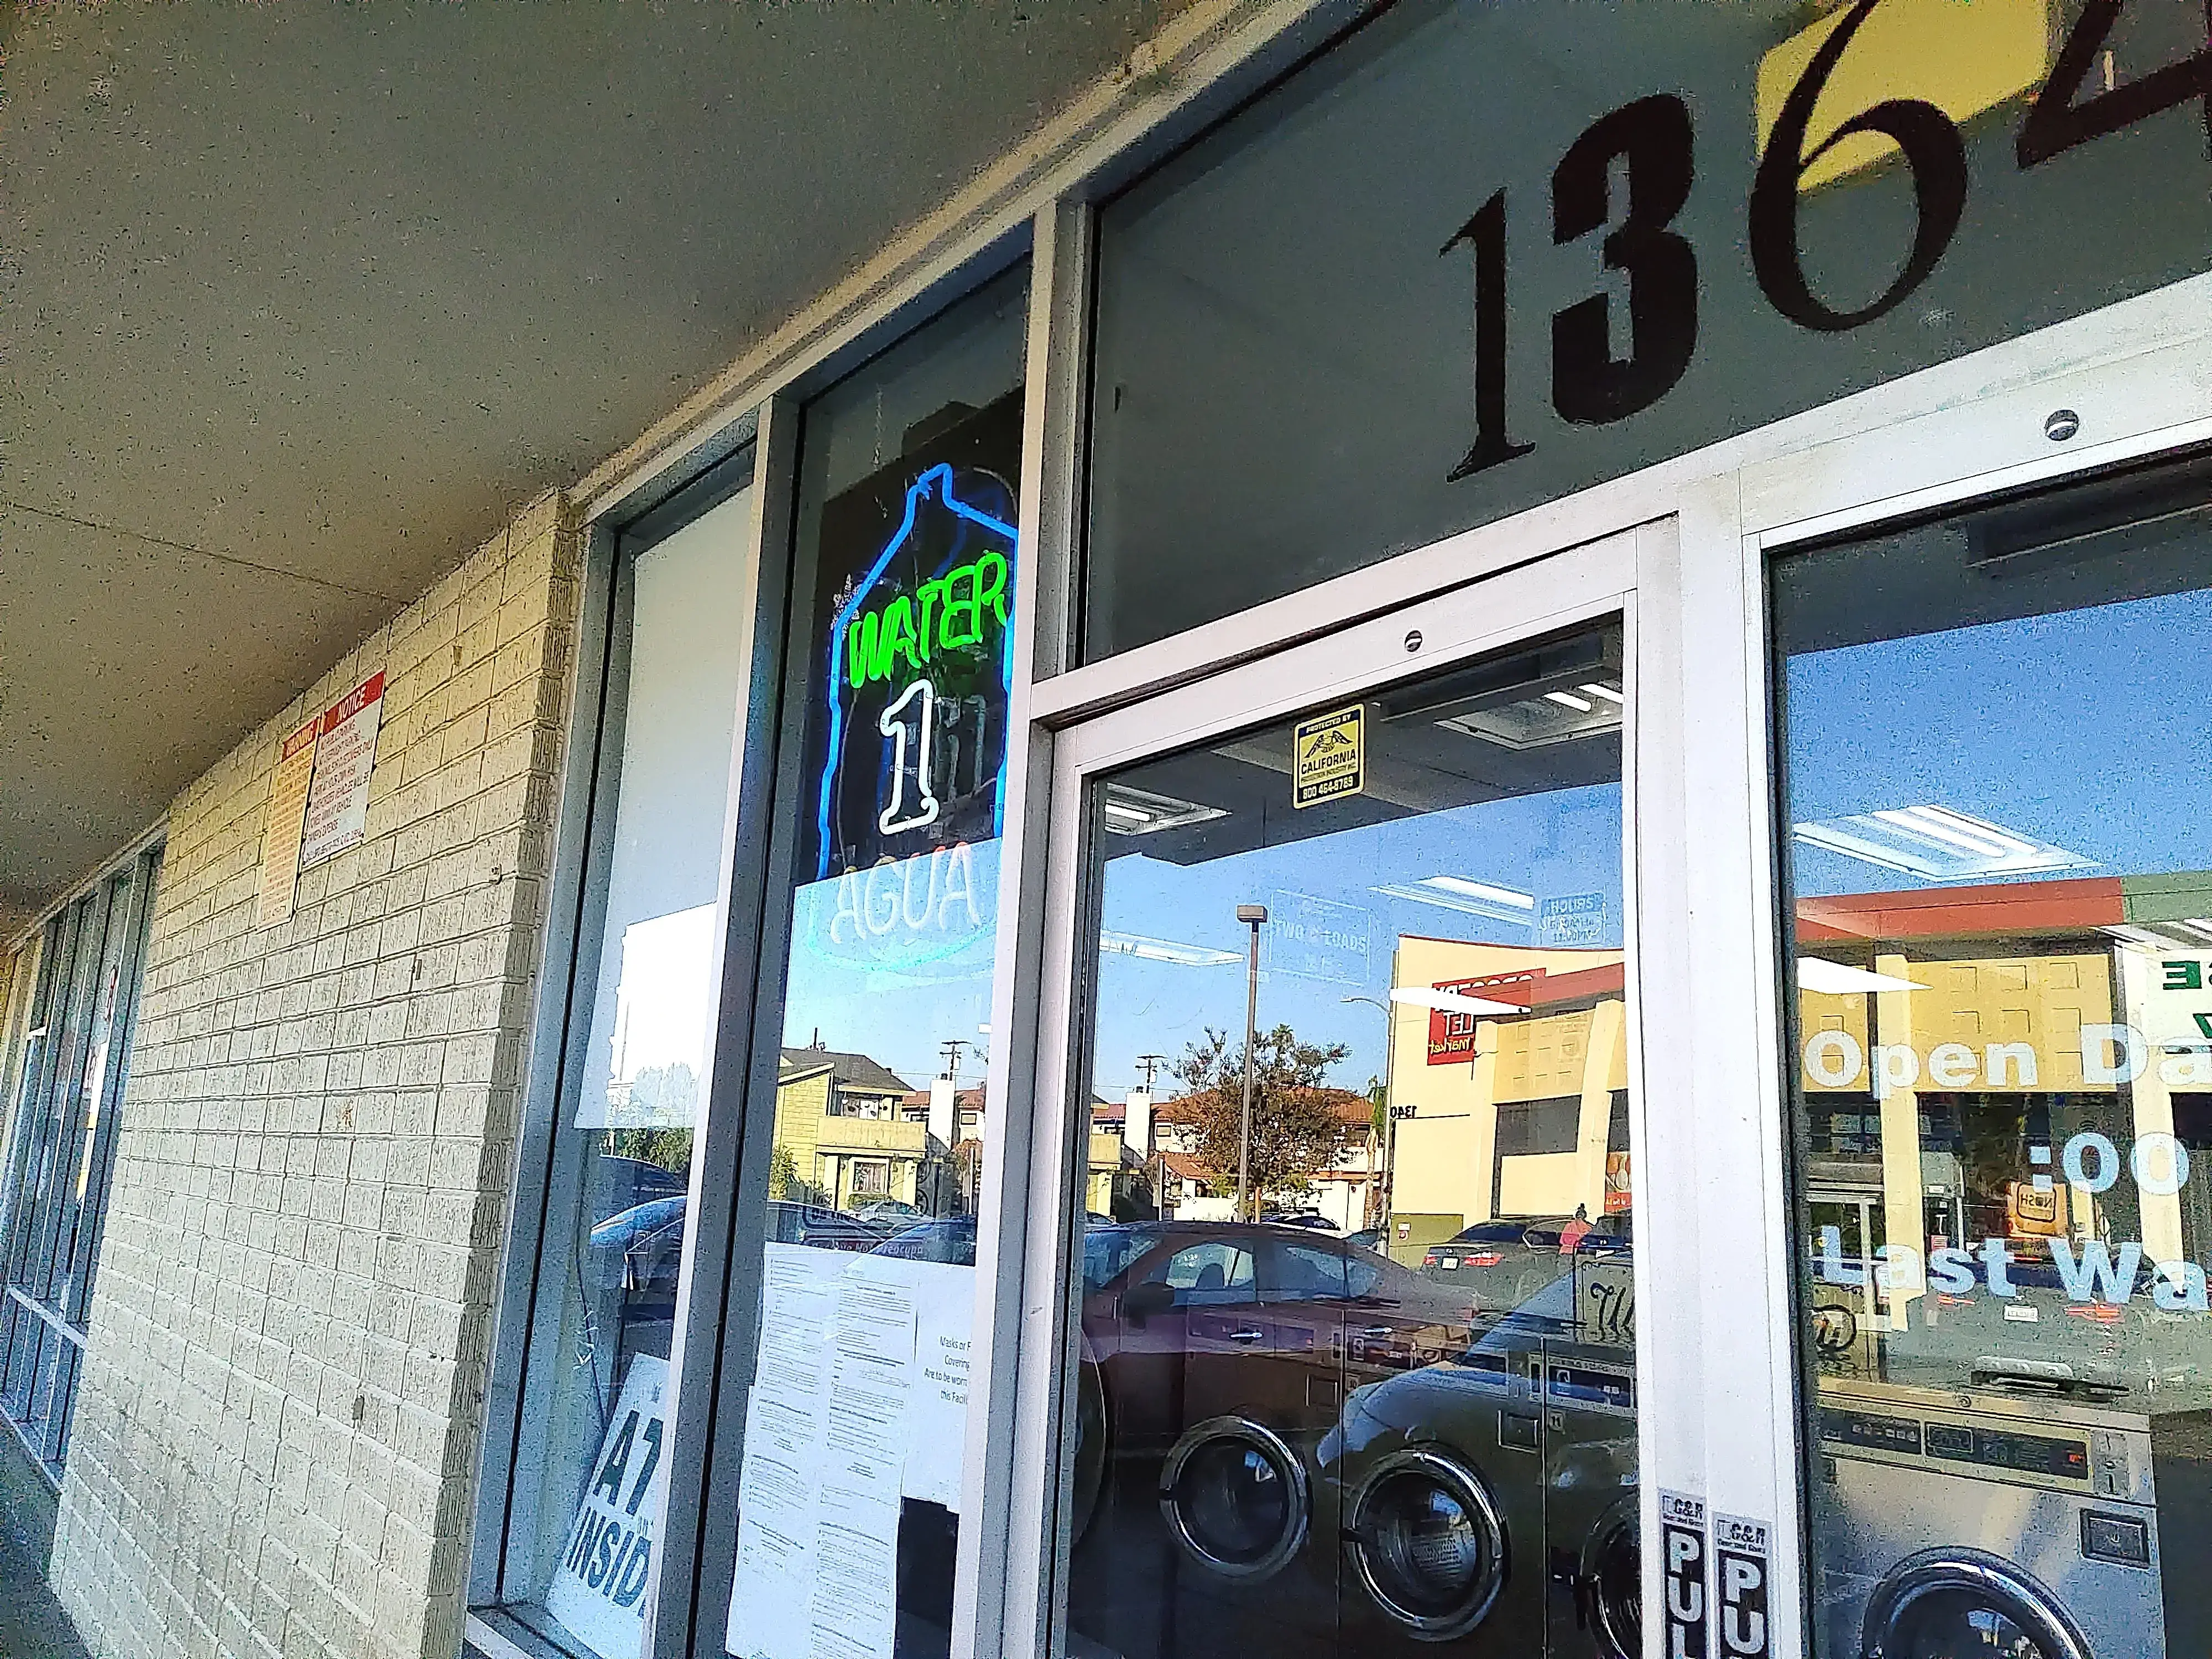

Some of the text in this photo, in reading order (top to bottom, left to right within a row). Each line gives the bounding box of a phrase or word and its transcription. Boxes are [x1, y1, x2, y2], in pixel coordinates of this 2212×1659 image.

[1439, 0, 2212, 482] 1364
[848, 550, 1010, 689] WATER
[335, 686, 366, 723] NOTICE
[879, 678, 940, 836] 1
[1301, 748, 1357, 775] CALIFORNIA
[1302, 785, 1317, 800] 800
[831, 842, 983, 945] AGUA
[1806, 1029, 2038, 1100] Open
[2080, 1023, 2212, 1086] Da
[1820, 1225, 2209, 1311] Last Wa
[924, 1368, 935, 1379] Are
[936, 1371, 942, 1380] to
[943, 1372, 950, 1383] be
[940, 1335, 958, 1349] Masks
[941, 1389, 951, 1401] this
[566, 1506, 653, 1620] INSID
